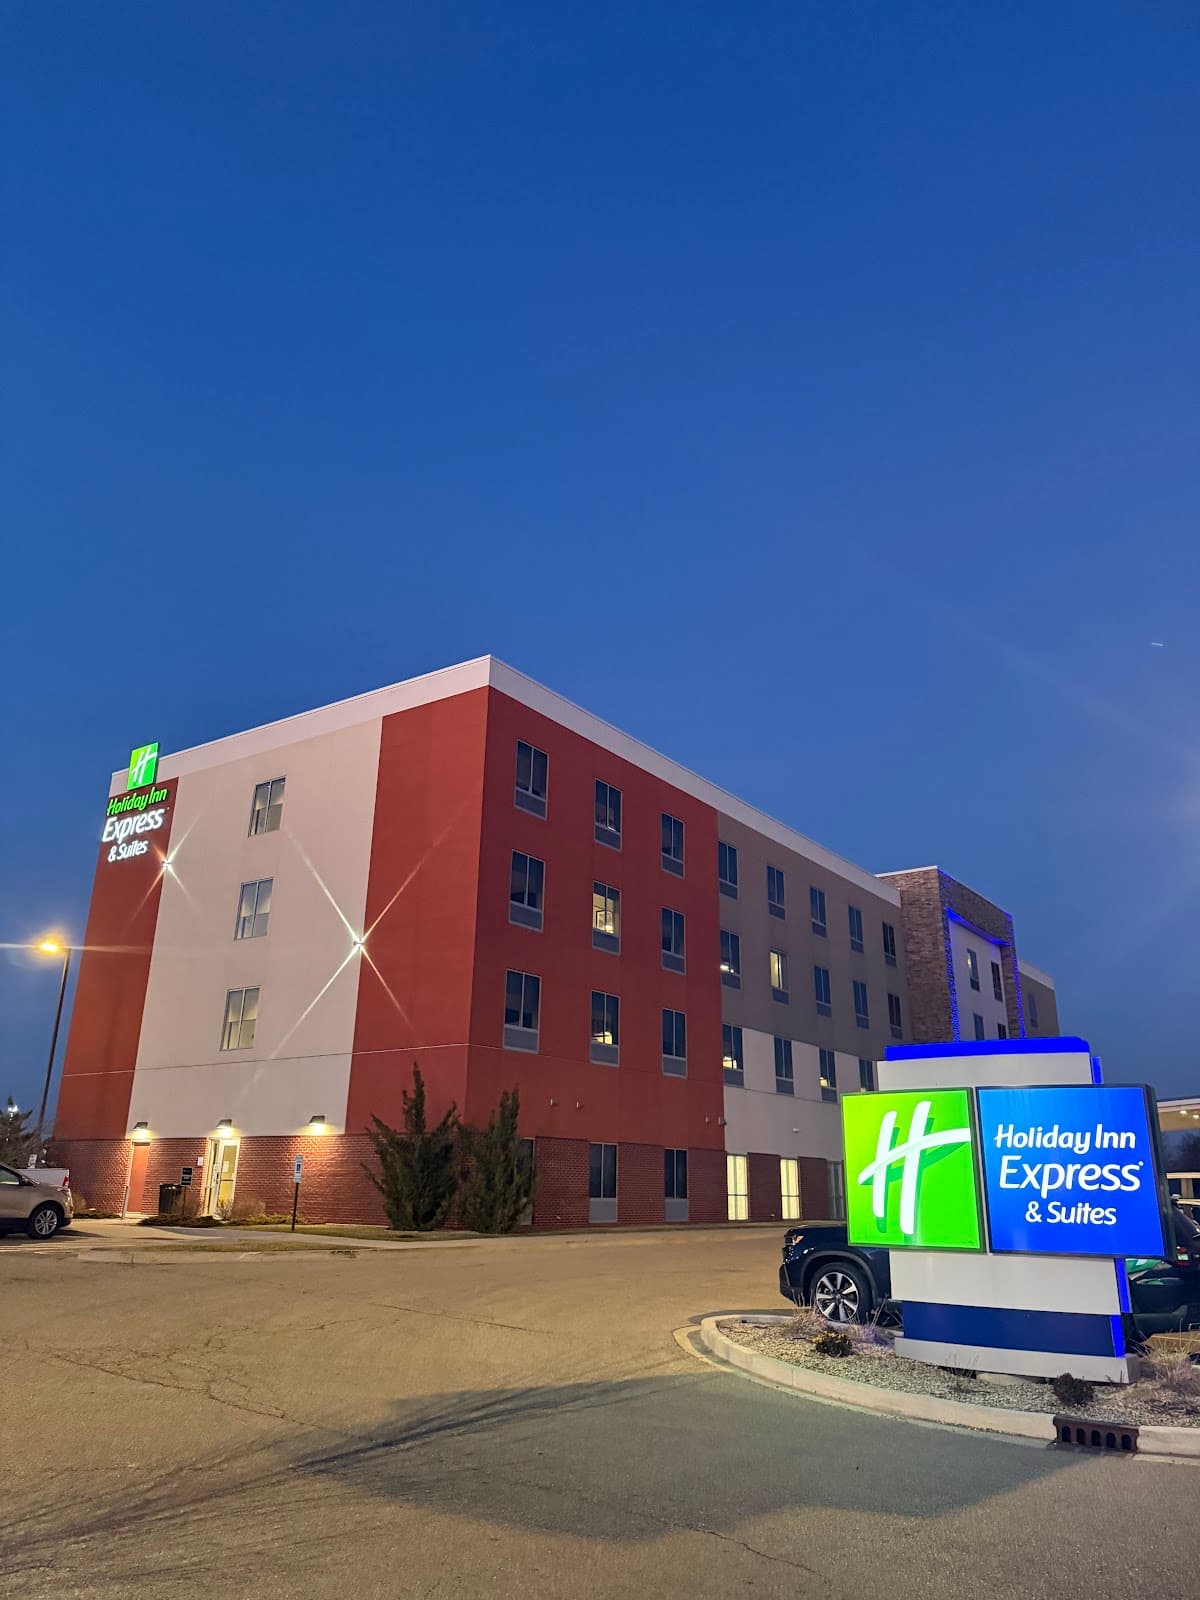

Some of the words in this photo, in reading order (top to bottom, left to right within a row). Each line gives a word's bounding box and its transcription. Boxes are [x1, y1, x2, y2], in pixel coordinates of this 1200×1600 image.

[107, 793, 149, 816] Holiday
[148, 787, 167, 804] Inn
[102, 808, 165, 844] Express
[108, 846, 117, 862] &
[117, 840, 148, 860] Suites
[994, 1124, 1090, 1154] Holiday
[1095, 1124, 1136, 1149] Inn
[858, 1101, 971, 1235] H
[1000, 1155, 1141, 1199] Express
[1025, 1201, 1042, 1223] &
[1047, 1201, 1117, 1226] Suites
